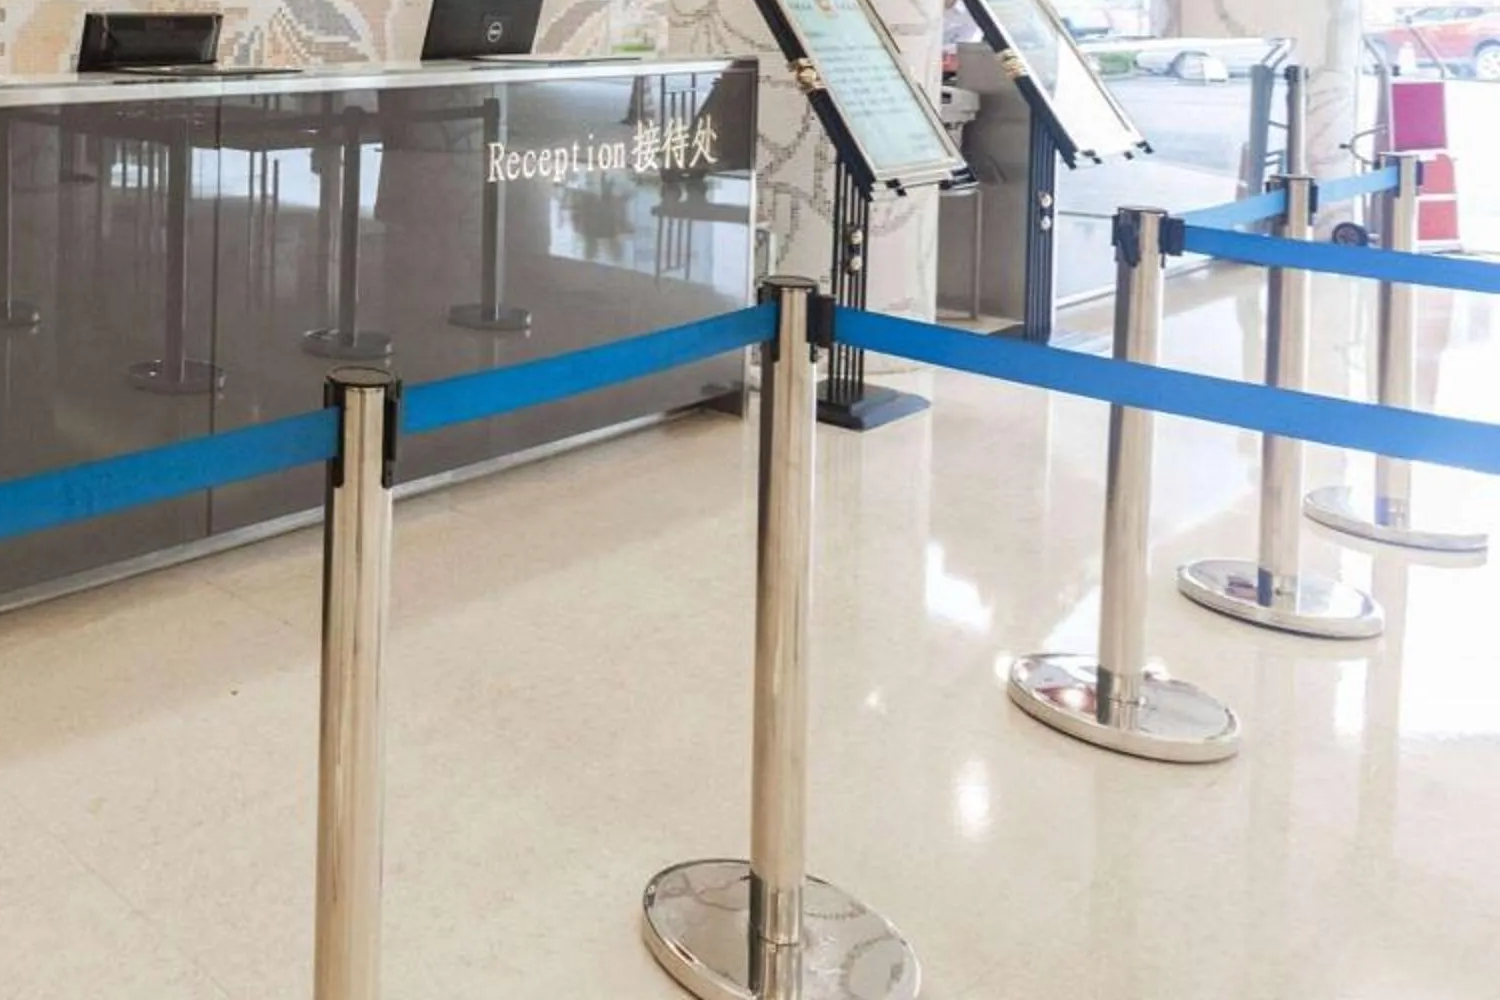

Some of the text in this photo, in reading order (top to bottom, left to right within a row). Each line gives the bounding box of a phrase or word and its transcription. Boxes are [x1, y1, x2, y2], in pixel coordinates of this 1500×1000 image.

[487, 114, 718, 183] Reception 接待处
